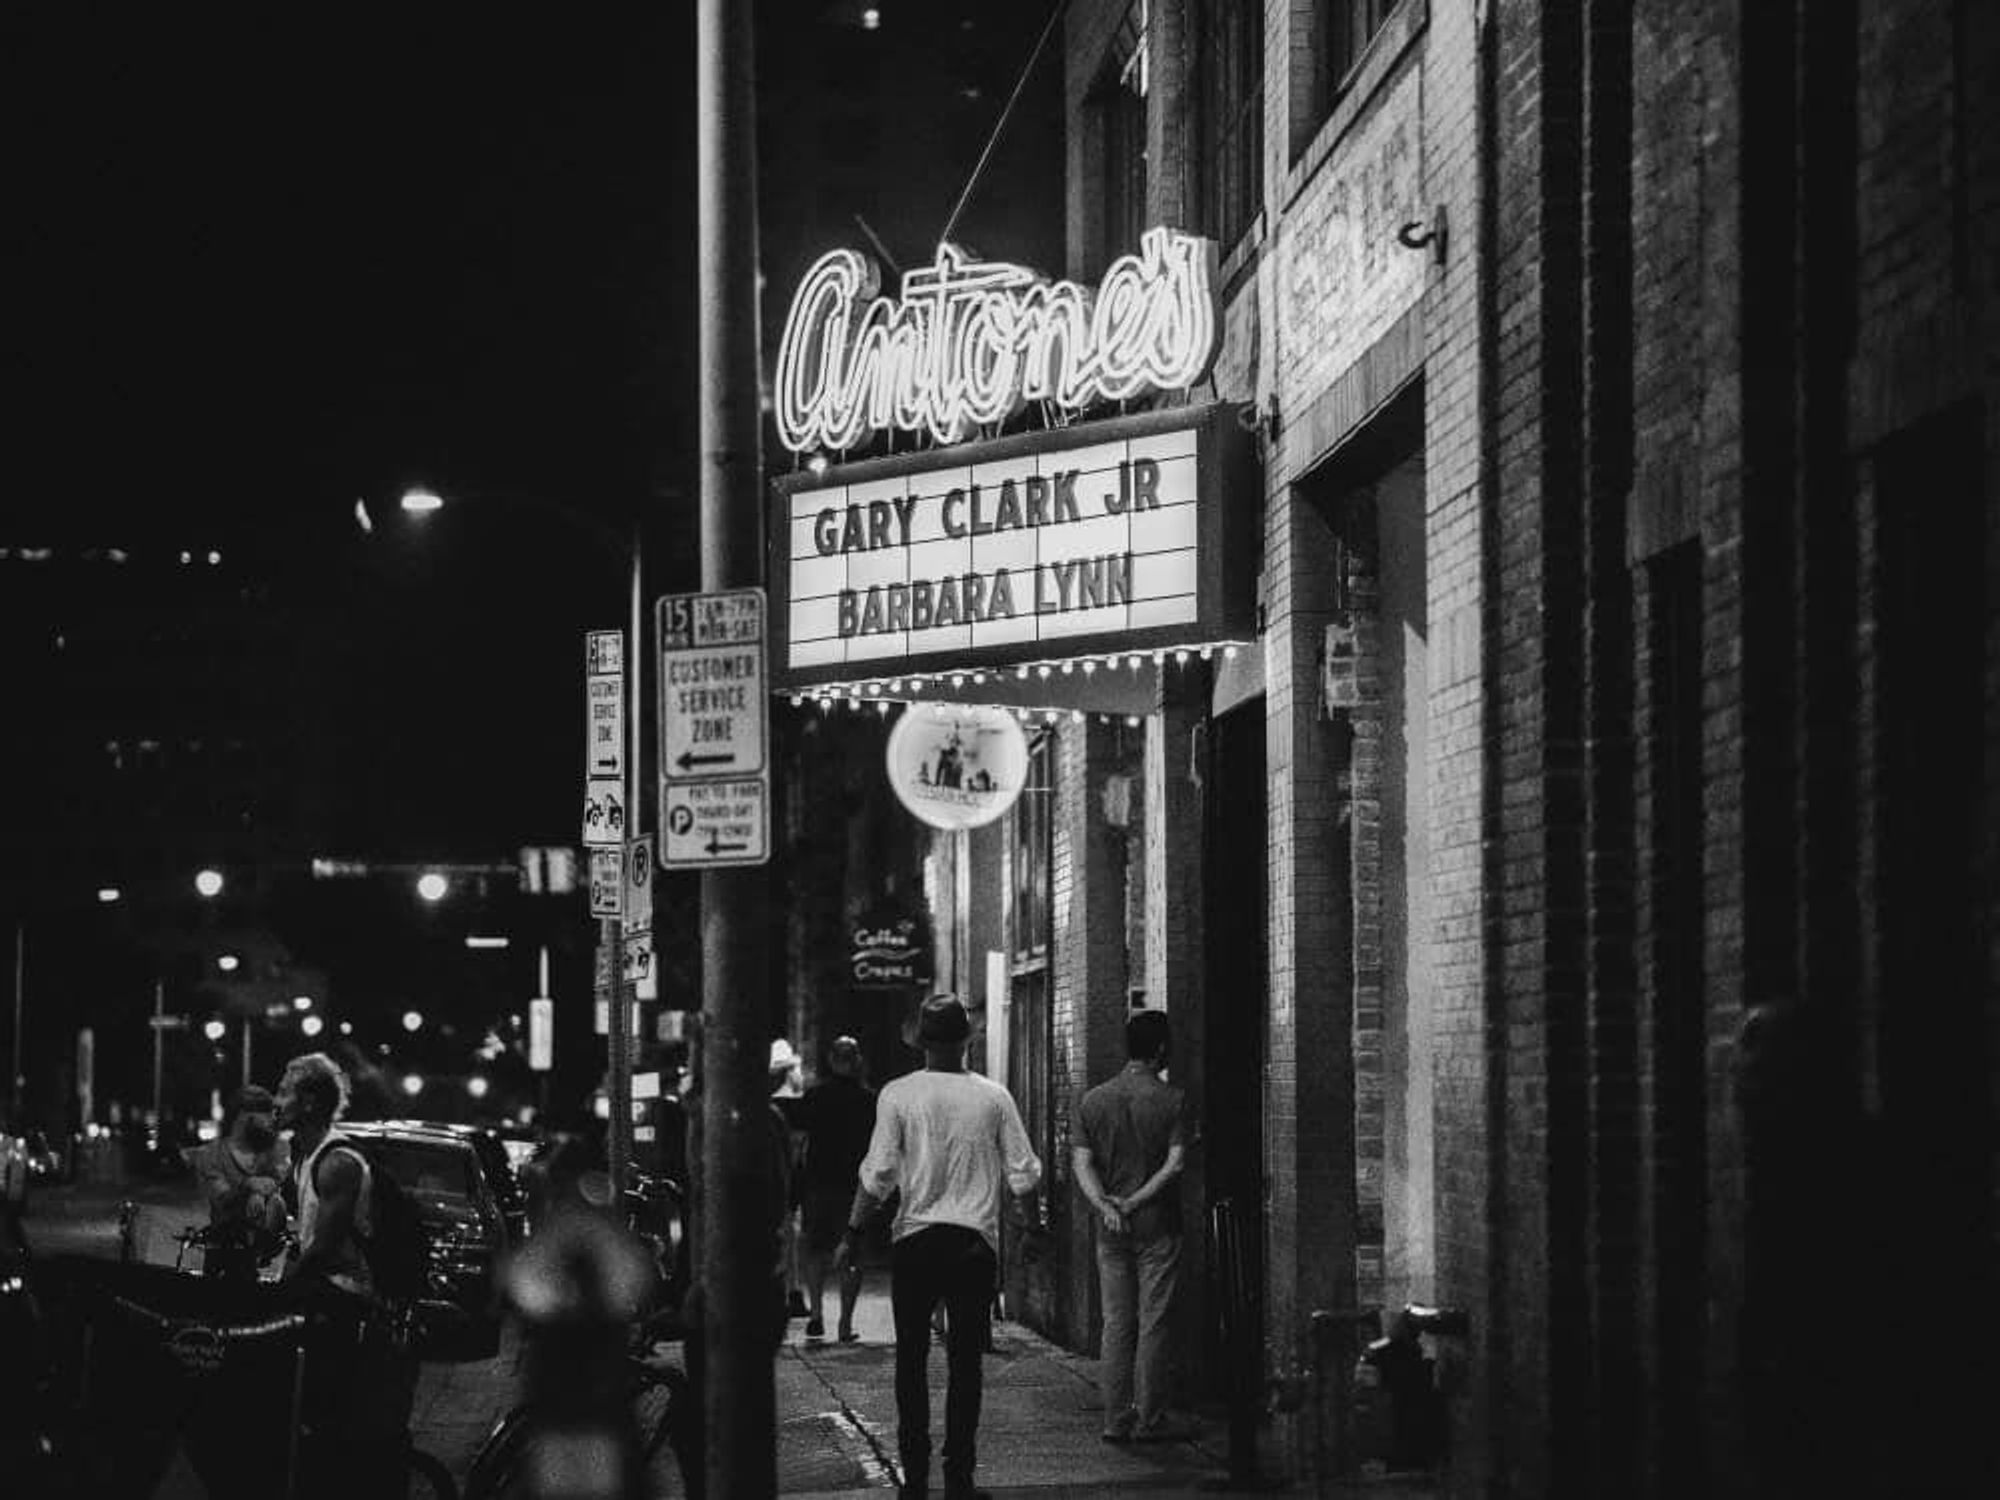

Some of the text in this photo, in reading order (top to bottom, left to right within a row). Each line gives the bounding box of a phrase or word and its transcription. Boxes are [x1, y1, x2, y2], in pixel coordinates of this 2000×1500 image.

[814, 458, 1162, 556] GARY CLARK JR
[838, 552, 1132, 638] BARBARA LYNN
[665, 600, 688, 631] 15
[671, 655, 755, 685] CUSTOMER
[679, 686, 745, 713] SERVICE
[692, 717, 734, 743] ZONE
[854, 929, 908, 946] Coffee
